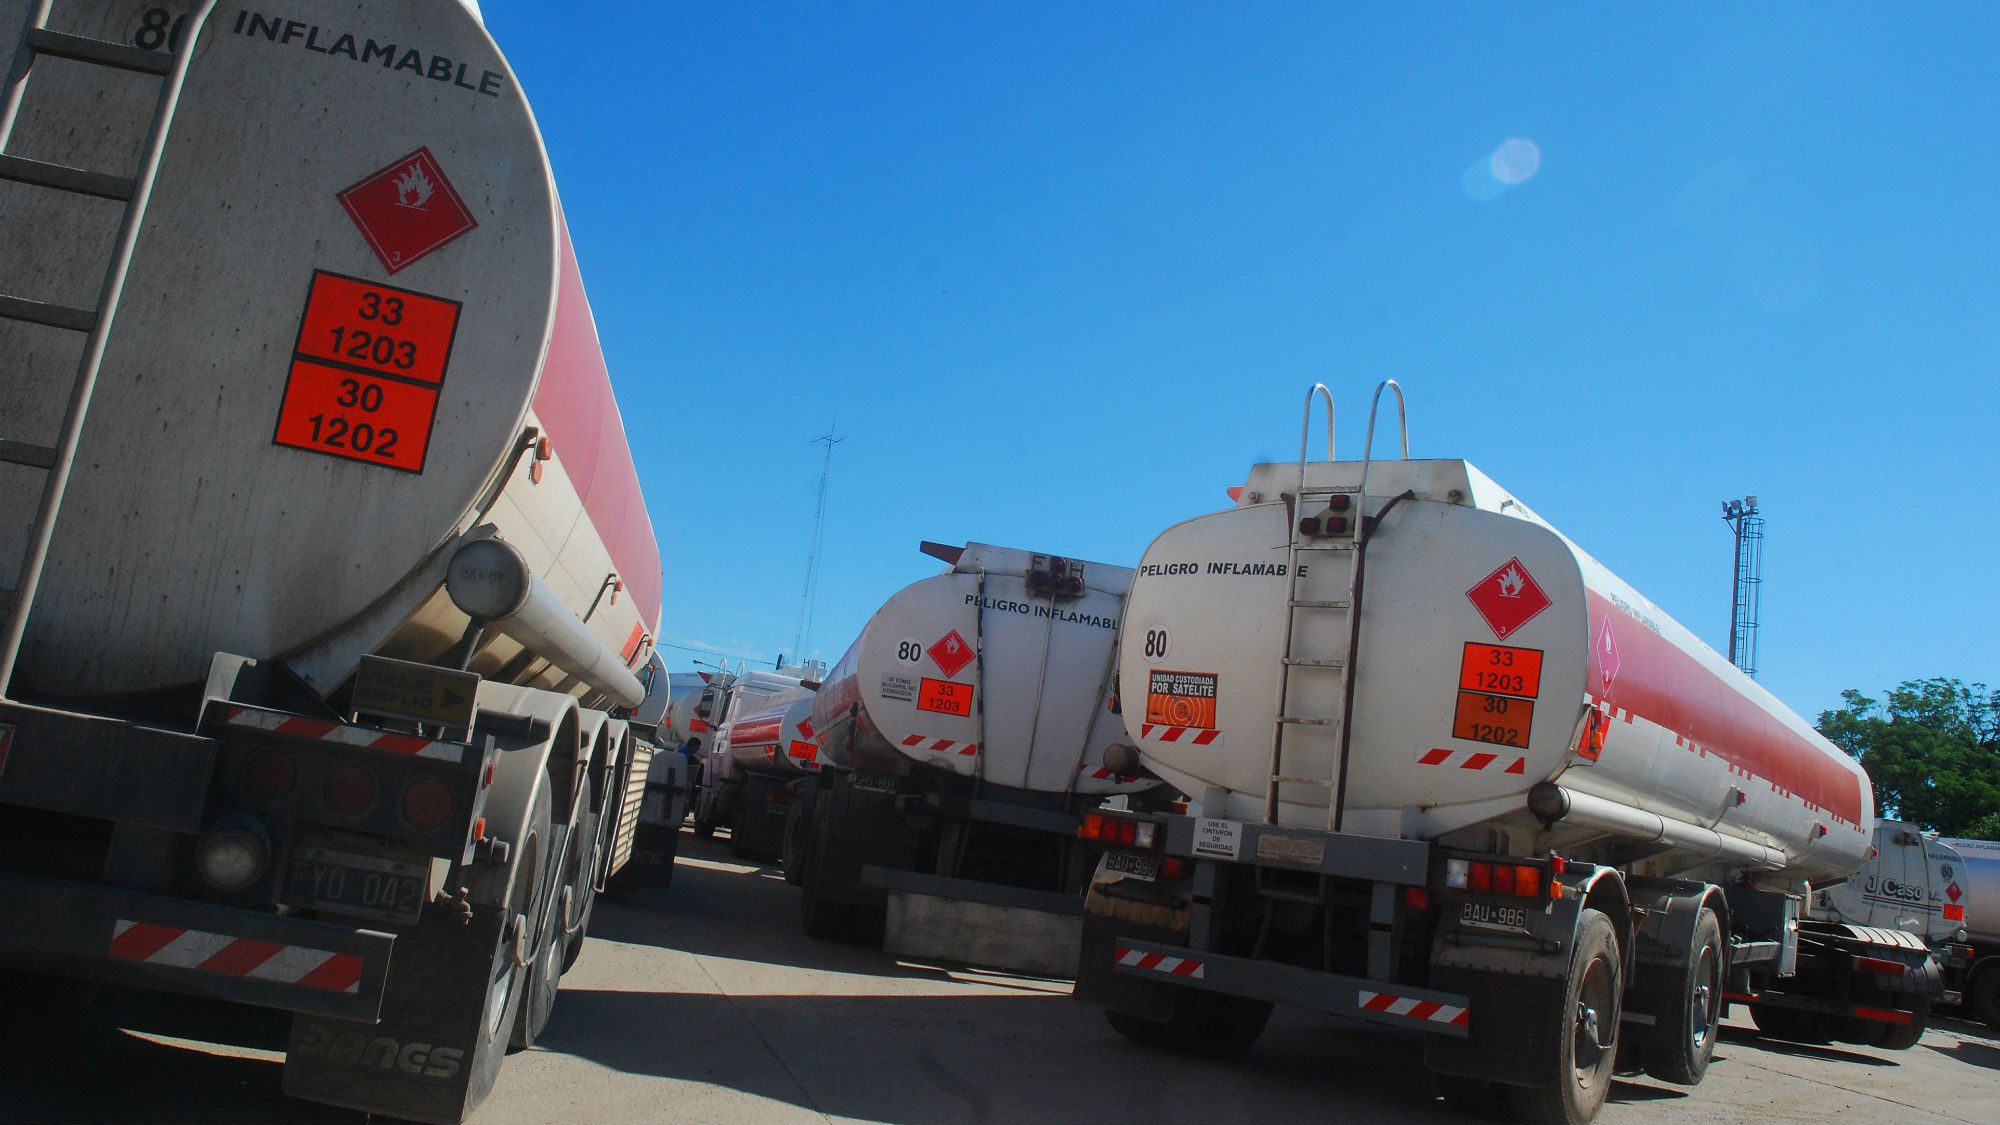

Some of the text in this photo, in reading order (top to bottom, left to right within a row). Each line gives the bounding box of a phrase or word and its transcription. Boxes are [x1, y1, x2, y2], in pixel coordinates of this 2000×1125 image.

[233, 10, 504, 98] INFLAMABLE
[393, 252, 400, 262] 3
[358, 292, 404, 326] 33
[330, 326, 417, 369] 1203
[337, 378, 384, 413] 30
[308, 414, 398, 458] 1202
[1140, 562, 1308, 578] PELIGRO INFLAMABE
[965, 595, 1118, 630] PELIGRO INFLAMABL
[898, 641, 921, 662] 80
[1145, 629, 1167, 658] 80
[1489, 649, 1514, 667] 33
[881, 682, 906, 690] ALCOHOL
[1152, 673, 1214, 685] UNIDAD CUSTODIADA
[1475, 672, 1524, 691] 1203
[882, 688, 912, 696] CONDUZCA
[938, 684, 954, 696] 33
[1151, 682, 1214, 696] POR SATELITE
[929, 698, 960, 712] 1203
[1483, 697, 1508, 715] 30
[1471, 723, 1518, 745] 1202
[1203, 828, 1233, 837] CINTURON
[1199, 841, 1233, 851] SEGURIDAD
[1942, 865, 1953, 879] 80
[1463, 903, 1524, 926] BAU 986
